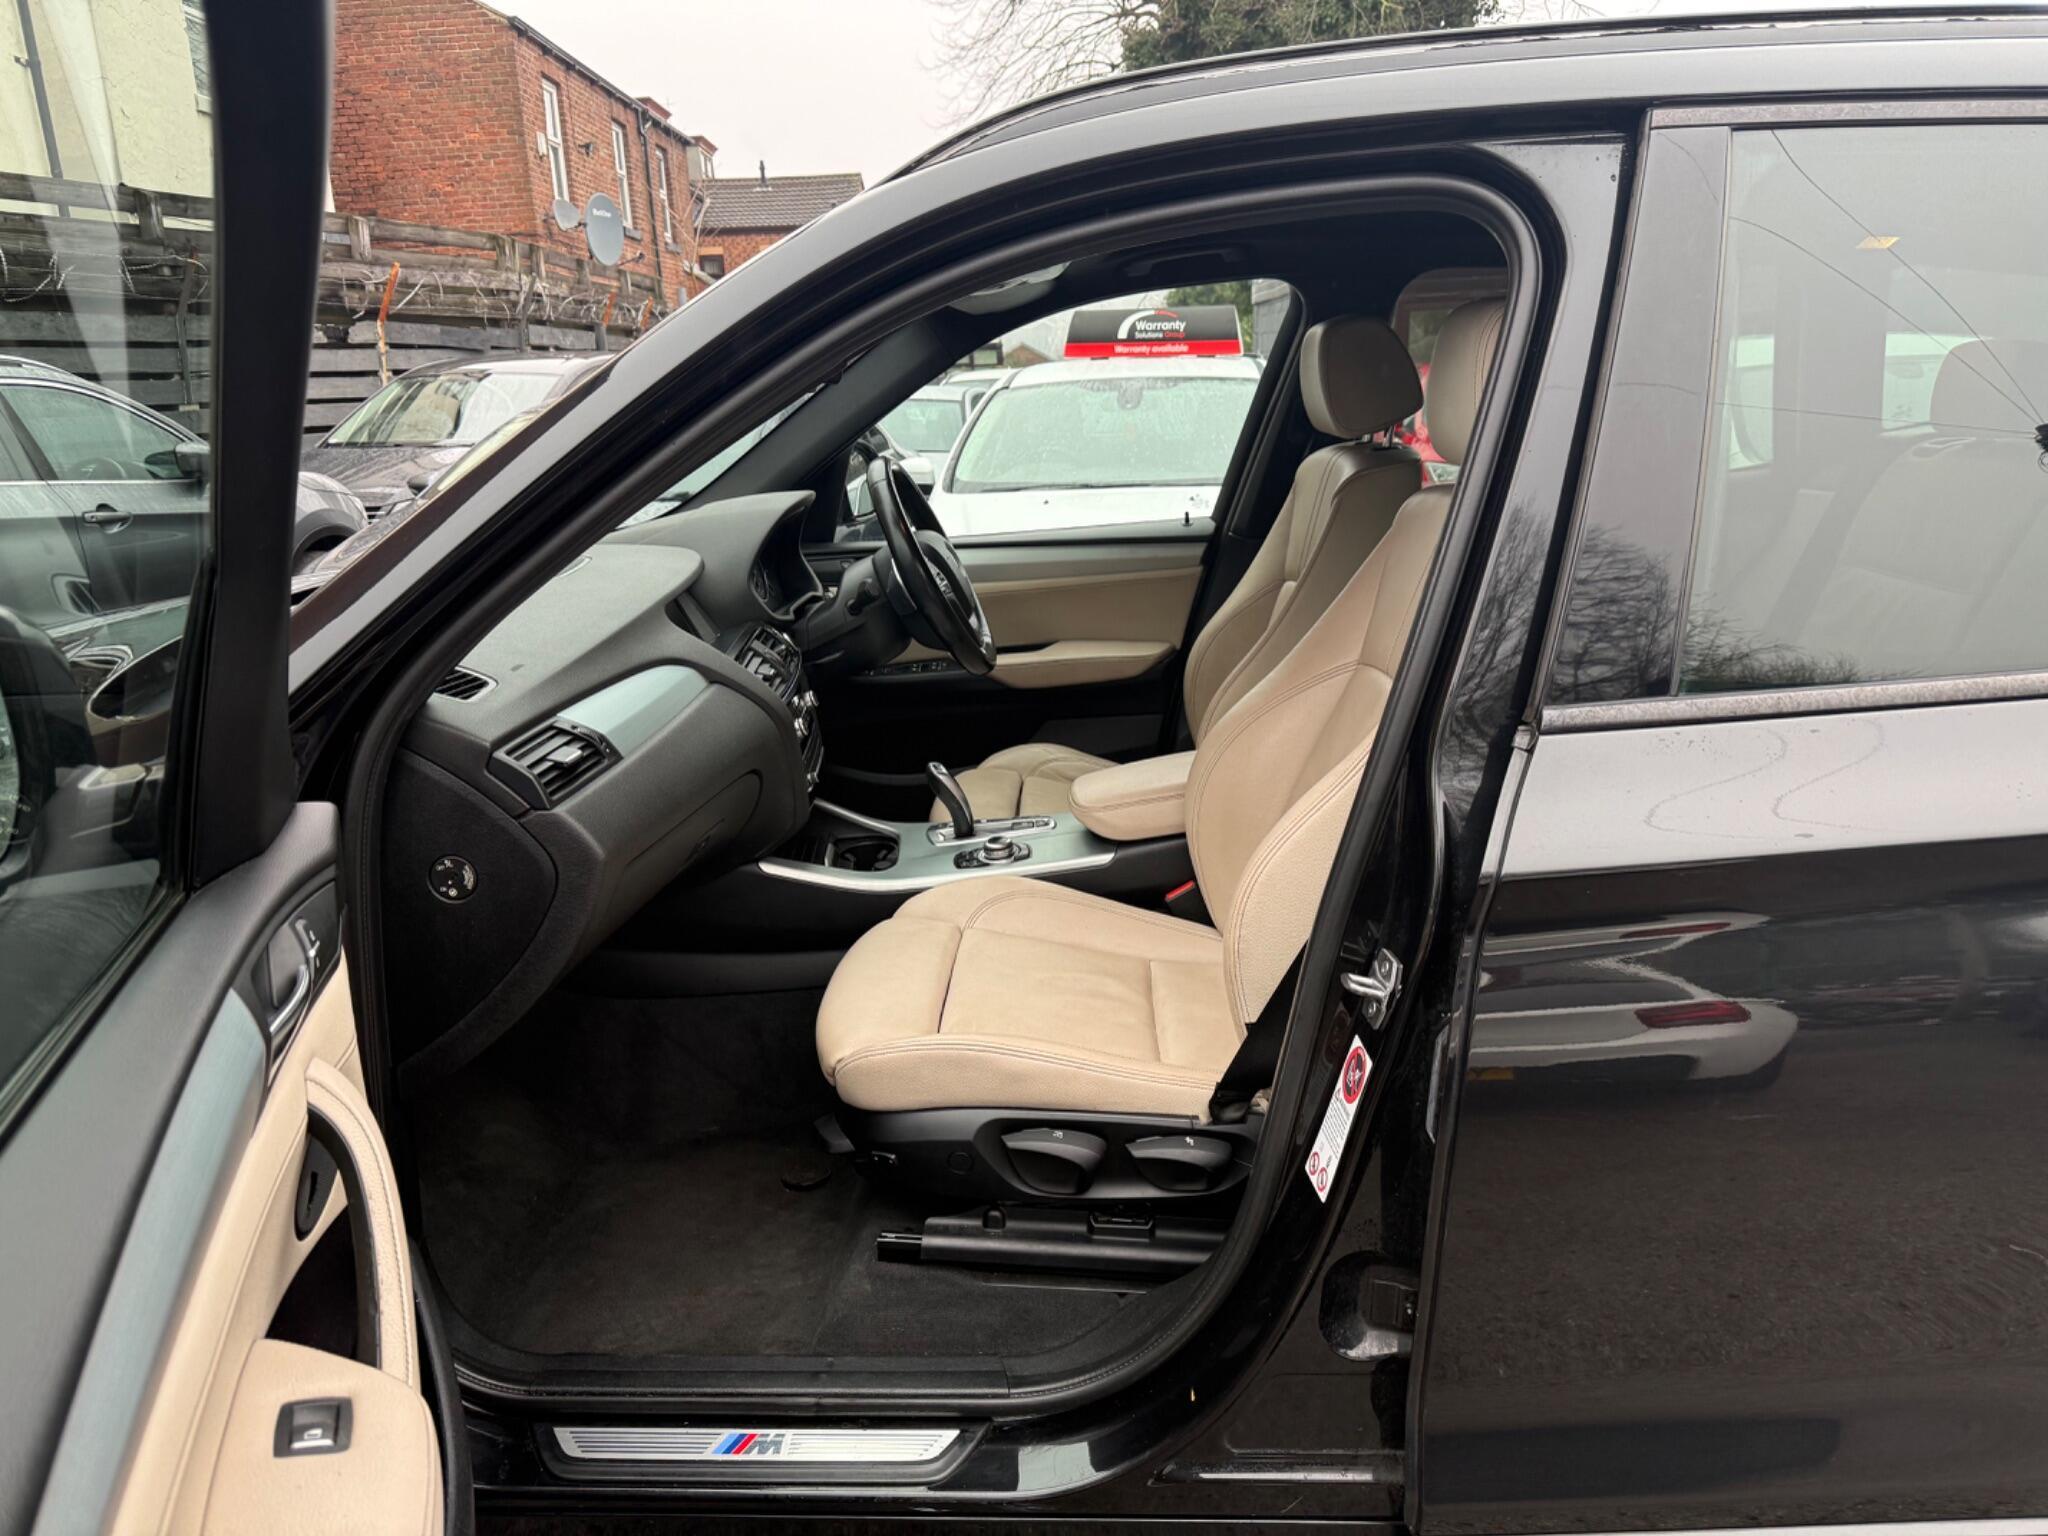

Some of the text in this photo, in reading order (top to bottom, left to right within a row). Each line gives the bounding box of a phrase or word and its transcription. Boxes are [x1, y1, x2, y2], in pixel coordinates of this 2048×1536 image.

[1135, 319, 1186, 332] Warranty
[1134, 331, 1163, 339] Solutions
[1114, 343, 1190, 356] Warranty available
[740, 1433, 786, 1455] M
